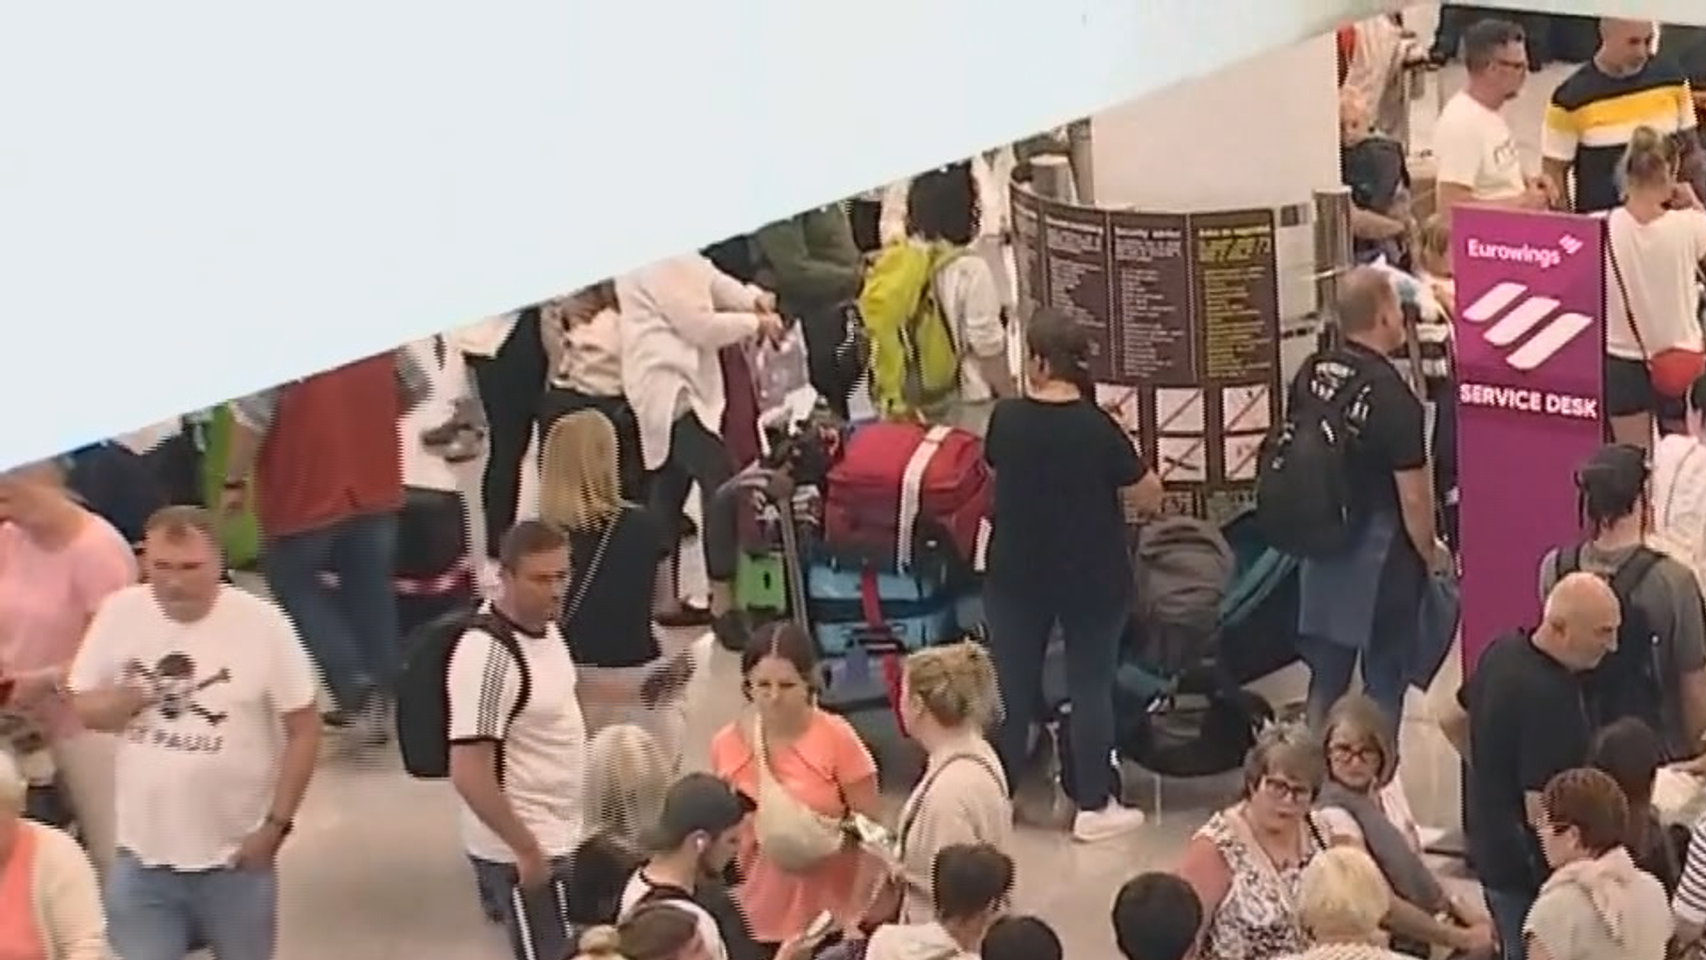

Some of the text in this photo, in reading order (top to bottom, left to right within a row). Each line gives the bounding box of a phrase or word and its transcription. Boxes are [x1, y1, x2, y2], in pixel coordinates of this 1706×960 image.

[1467, 238, 1561, 268] Eurowings
[1459, 382, 1598, 418] SERVICE DESK
